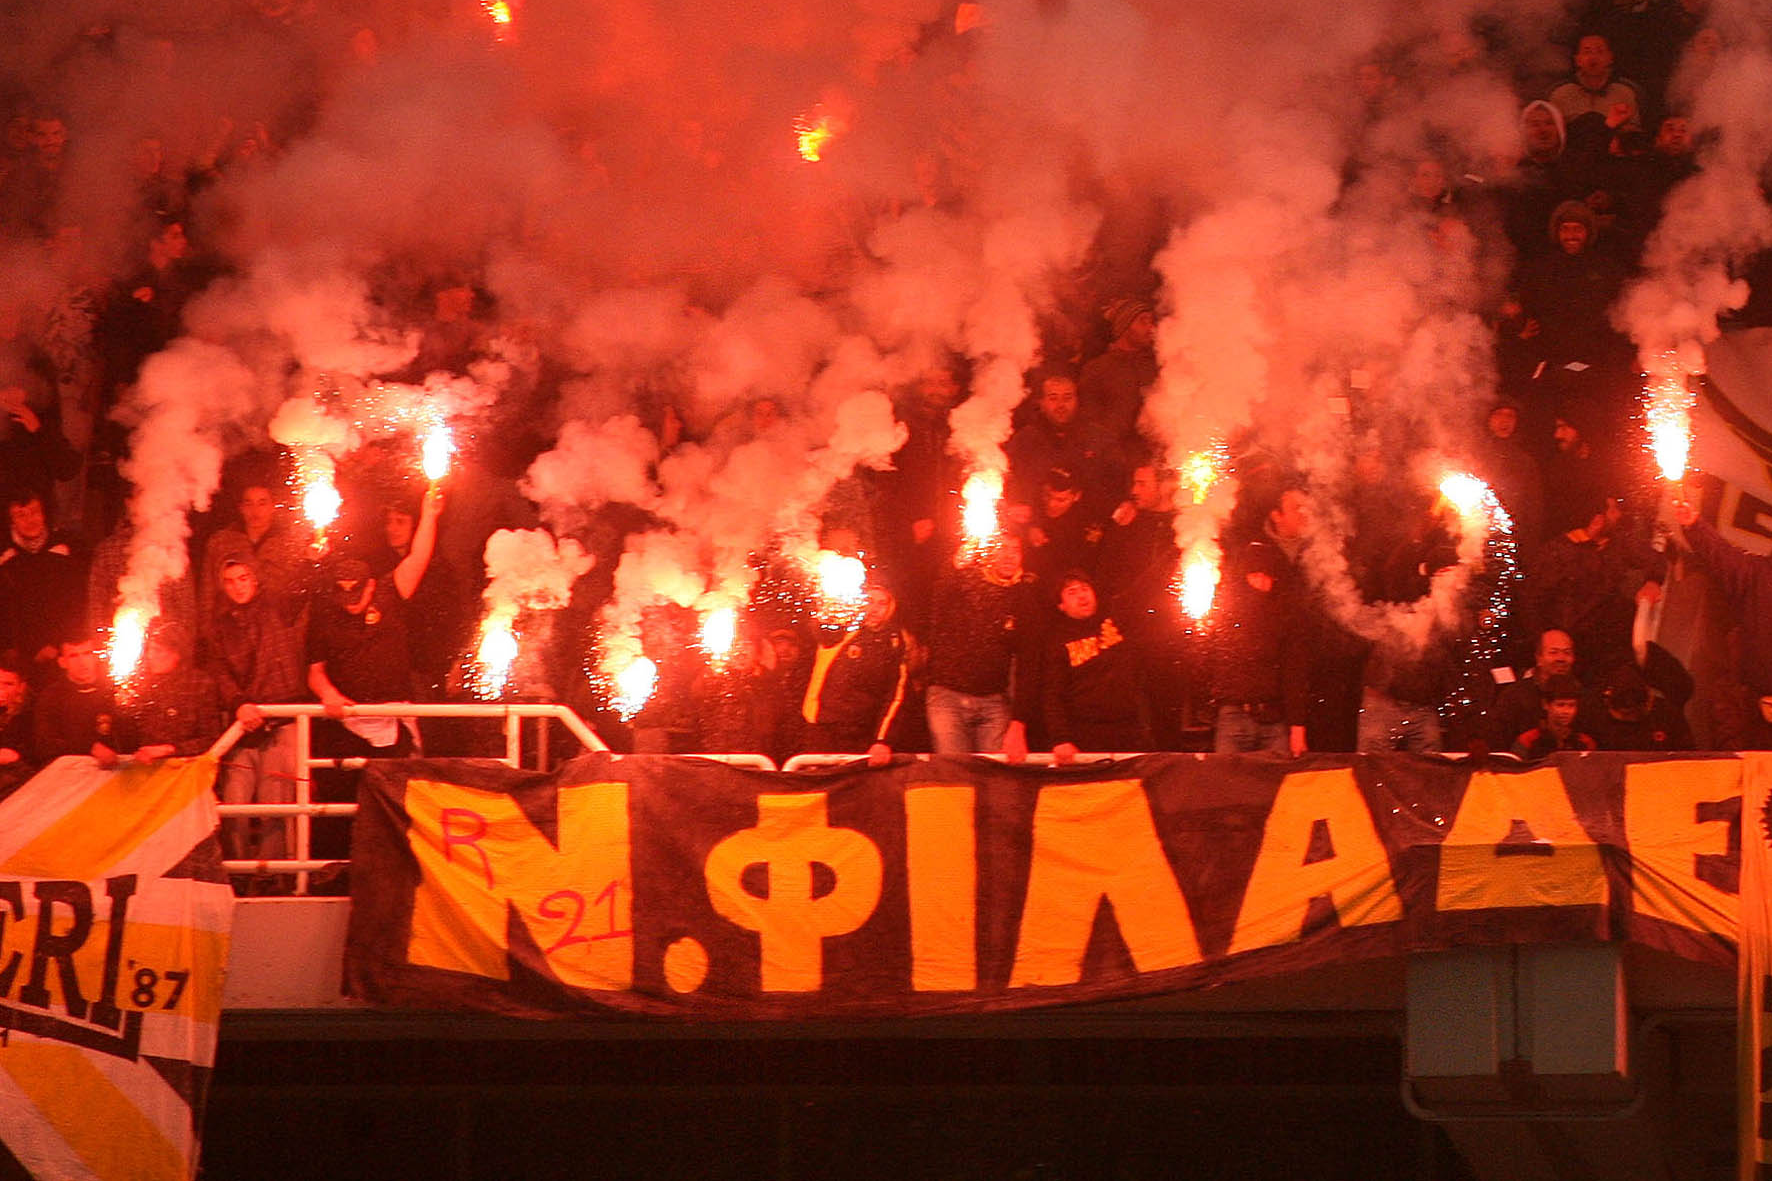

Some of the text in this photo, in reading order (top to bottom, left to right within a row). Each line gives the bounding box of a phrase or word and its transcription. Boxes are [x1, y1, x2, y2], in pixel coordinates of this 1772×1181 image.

[441, 808, 494, 890] R
[538, 880, 633, 954] 21
[127, 959, 190, 1009] '87
